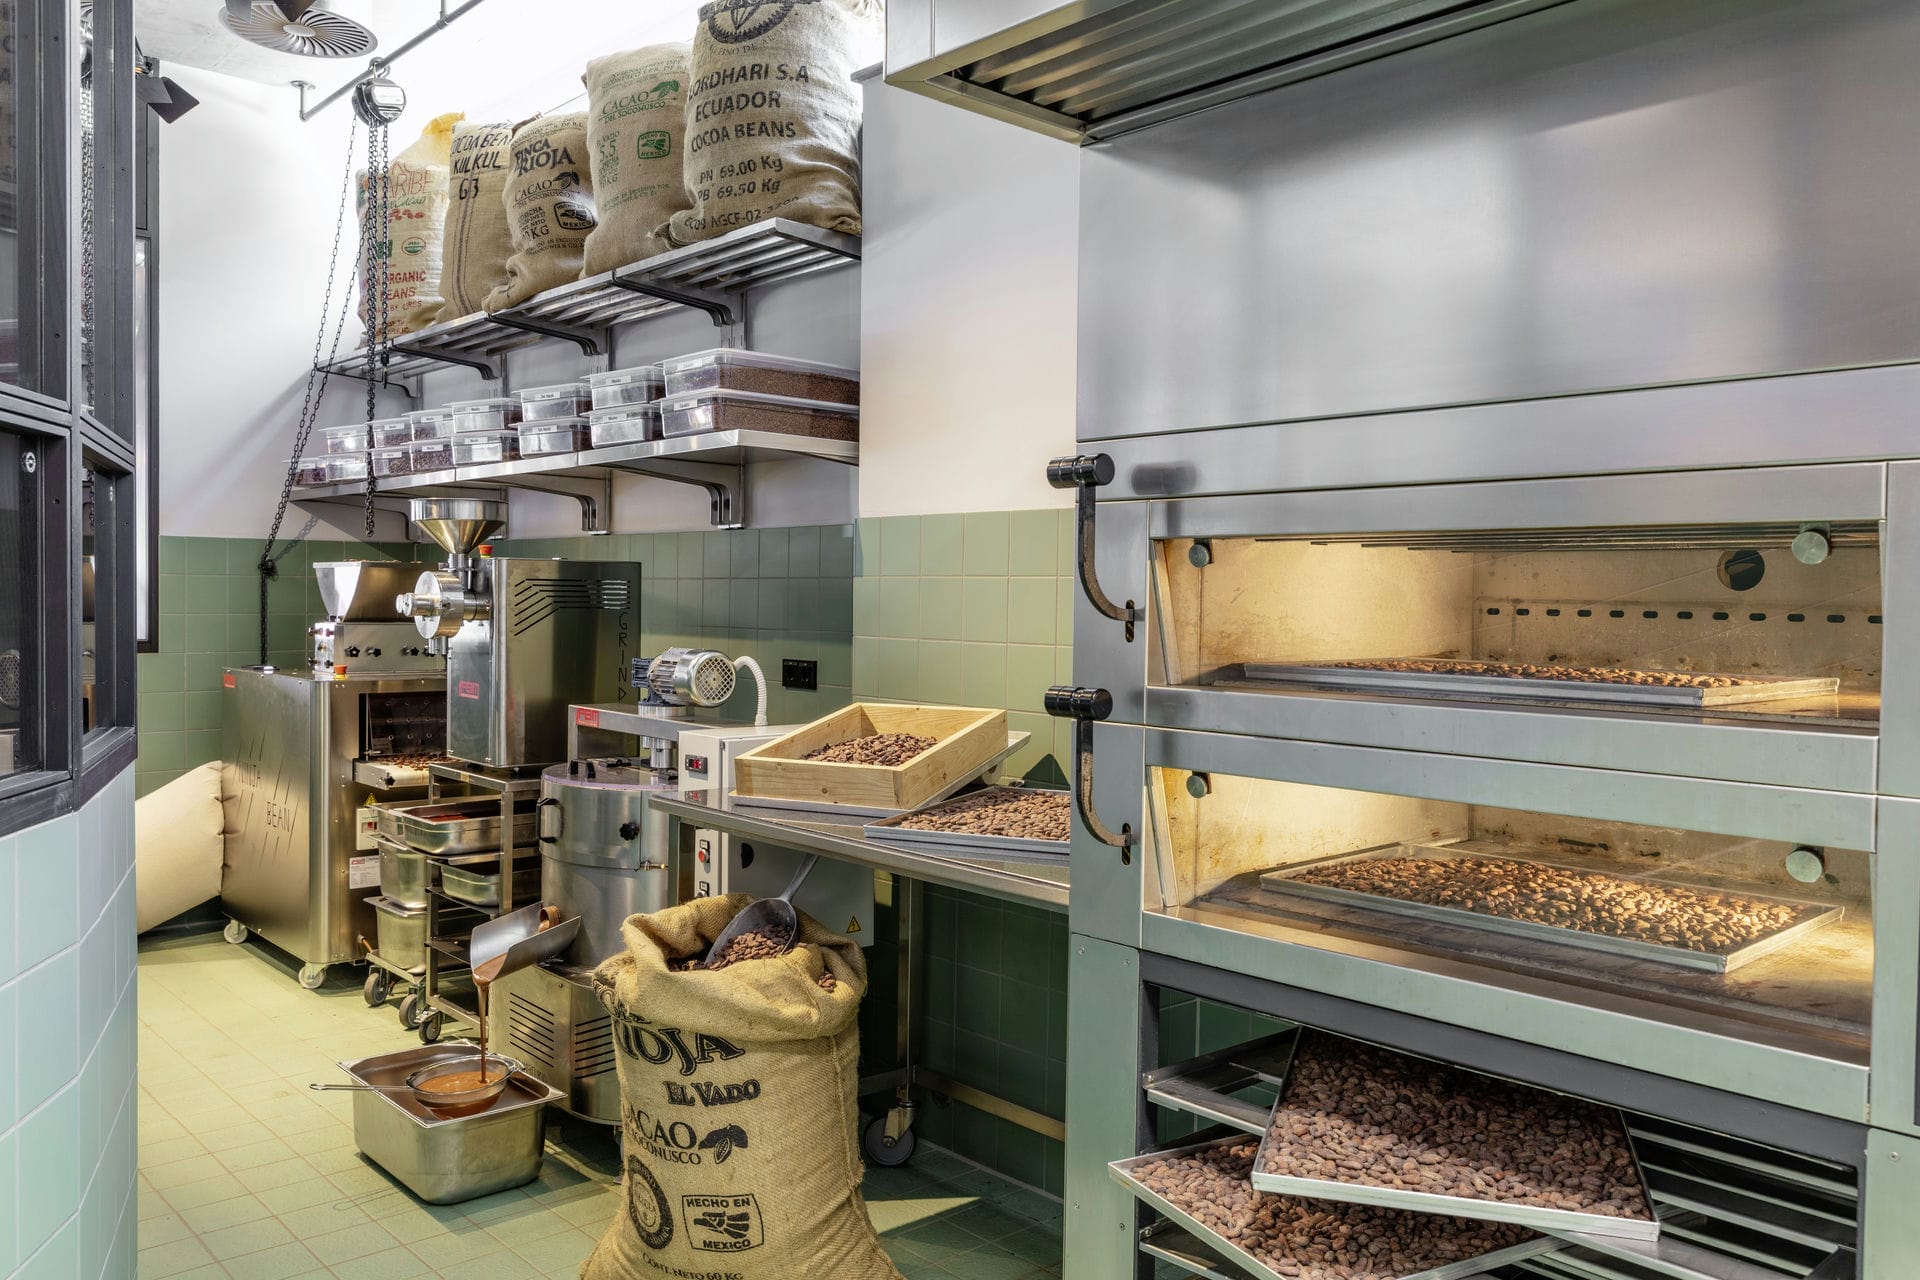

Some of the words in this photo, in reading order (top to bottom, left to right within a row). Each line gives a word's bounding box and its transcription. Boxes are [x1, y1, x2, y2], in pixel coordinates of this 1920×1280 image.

[603, 91, 649, 115] CACAO
[618, 101, 666, 118] SOCONUSCO
[695, 91, 781, 123] ECUADOR
[691, 127, 730, 152] COCOA
[735, 121, 796, 139] BEANS
[515, 138, 551, 163] FINCA
[517, 146, 576, 178] RIOJA
[700, 170, 713, 184] PN
[720, 159, 757, 179] 69.00
[761, 155, 784, 173] Kg
[459, 178, 479, 200] G3
[515, 179, 552, 202] CACAO
[717, 181, 756, 200] 69.50
[762, 178, 781, 194] Kg
[562, 220, 592, 228] MEXICO
[618, 611, 628, 704] GRIND
[266, 801, 290, 833] BEAN
[687, 1197, 730, 1208] HECHO
[733, 1197, 751, 1206] EN
[702, 1239, 751, 1250] MEXICO
[672, 1267, 703, 1280] NETO
